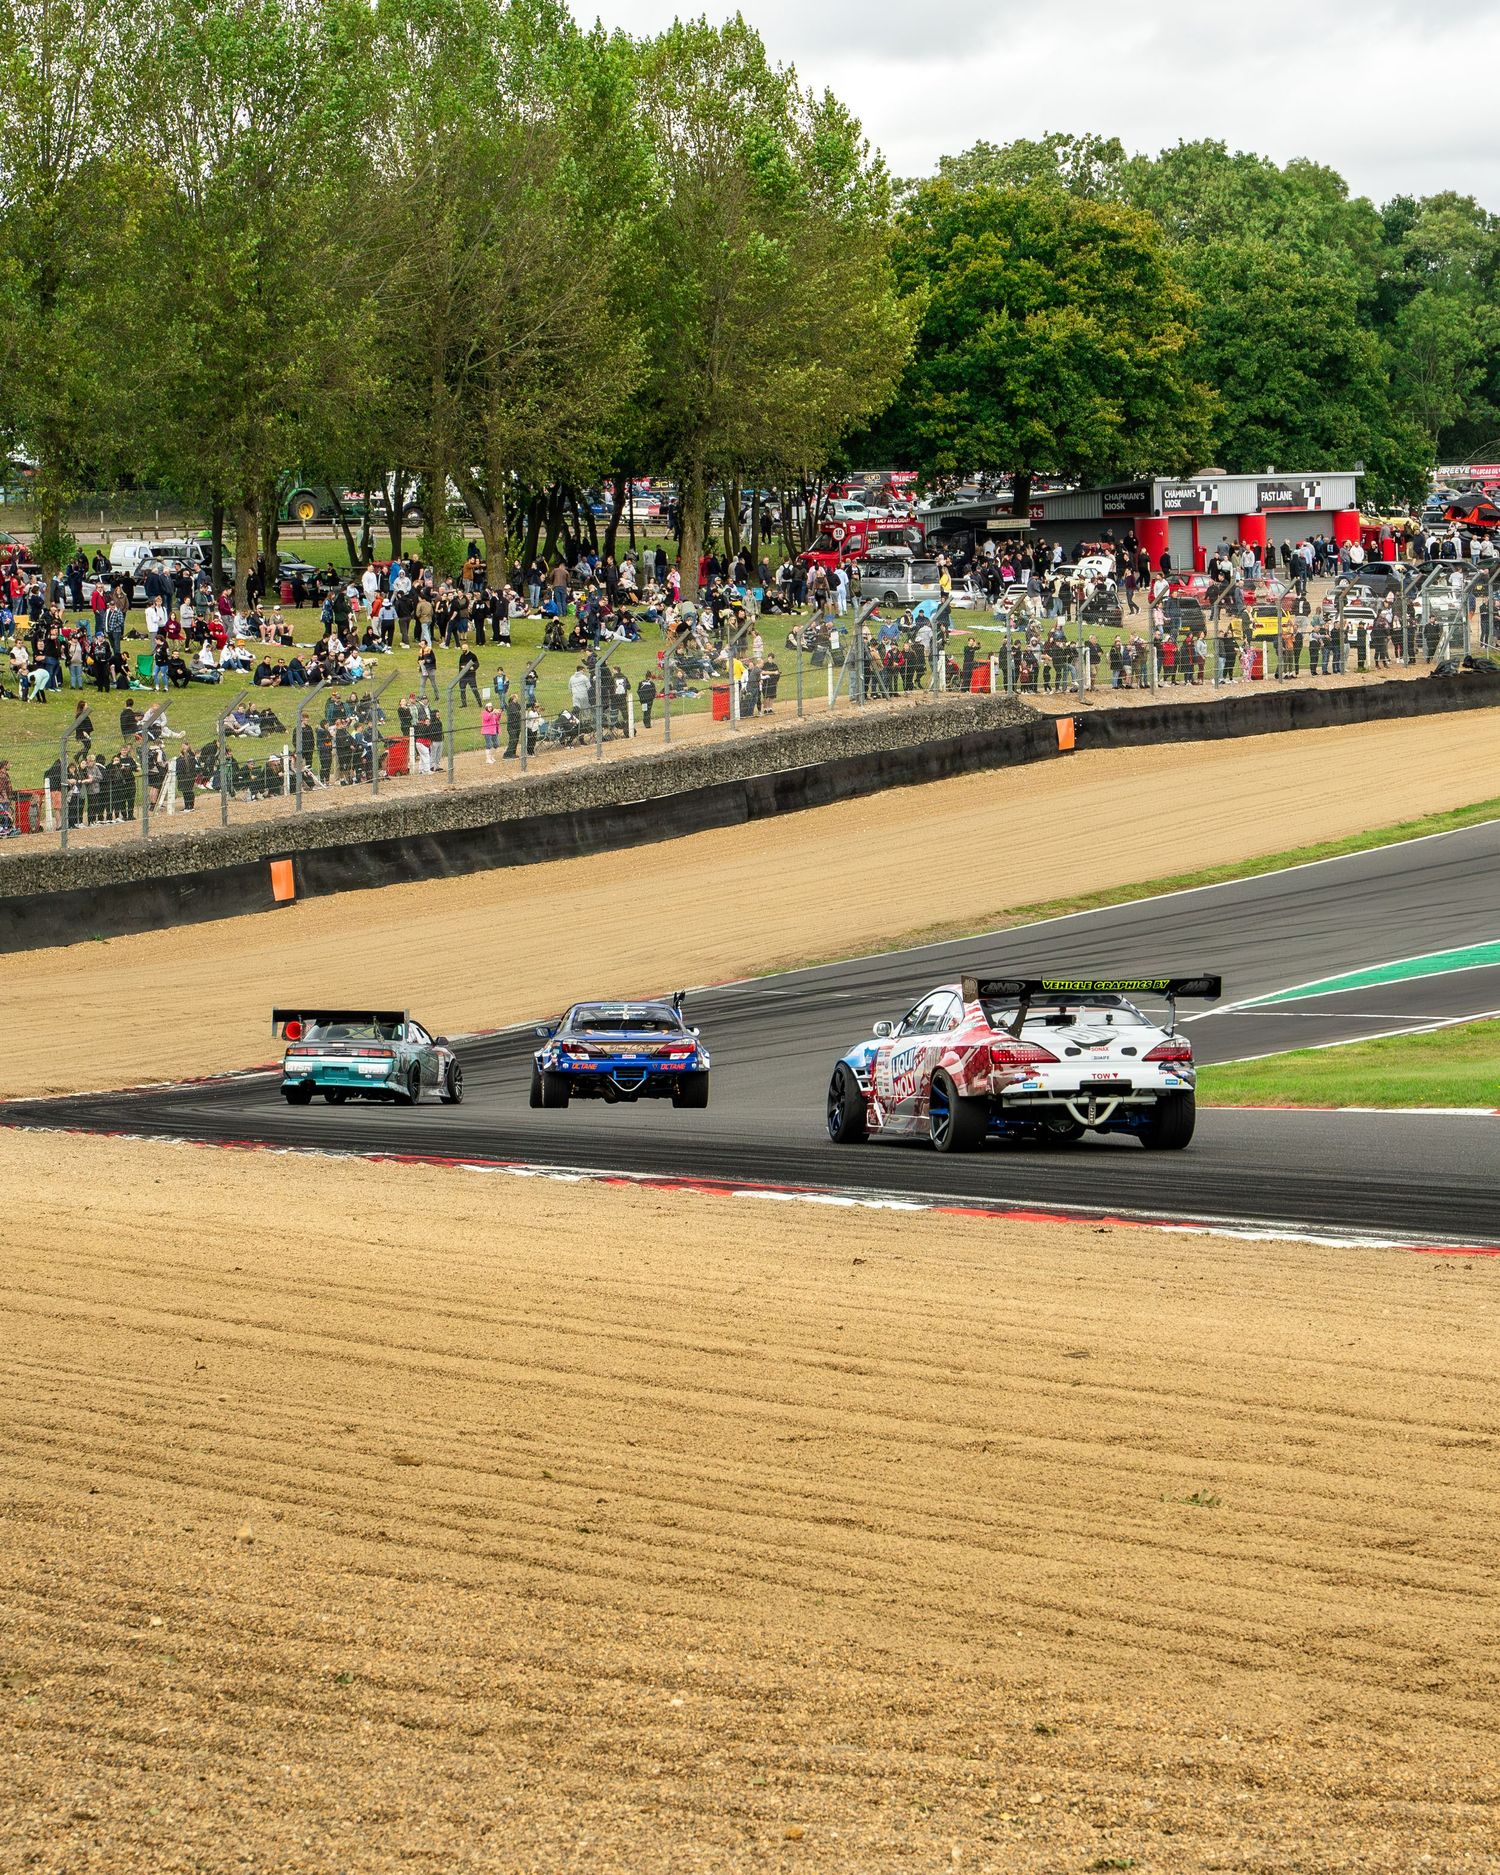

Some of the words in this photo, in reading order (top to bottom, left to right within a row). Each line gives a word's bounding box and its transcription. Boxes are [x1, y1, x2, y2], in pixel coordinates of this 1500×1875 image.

[1104, 492, 1145, 501] CHAPMAN'S
[1164, 488, 1197, 499] CHAPMAN'S
[1261, 490, 1276, 501] FAST
[1276, 490, 1292, 500] LANE
[1104, 502, 1125, 510] KIOSK
[1164, 499, 1181, 508] KIOSK
[1042, 980, 1092, 990] VEHICLE
[1093, 980, 1152, 990] GRAPHICS
[1153, 980, 1170, 989] BY
[894, 1071, 914, 1102] MOLY
